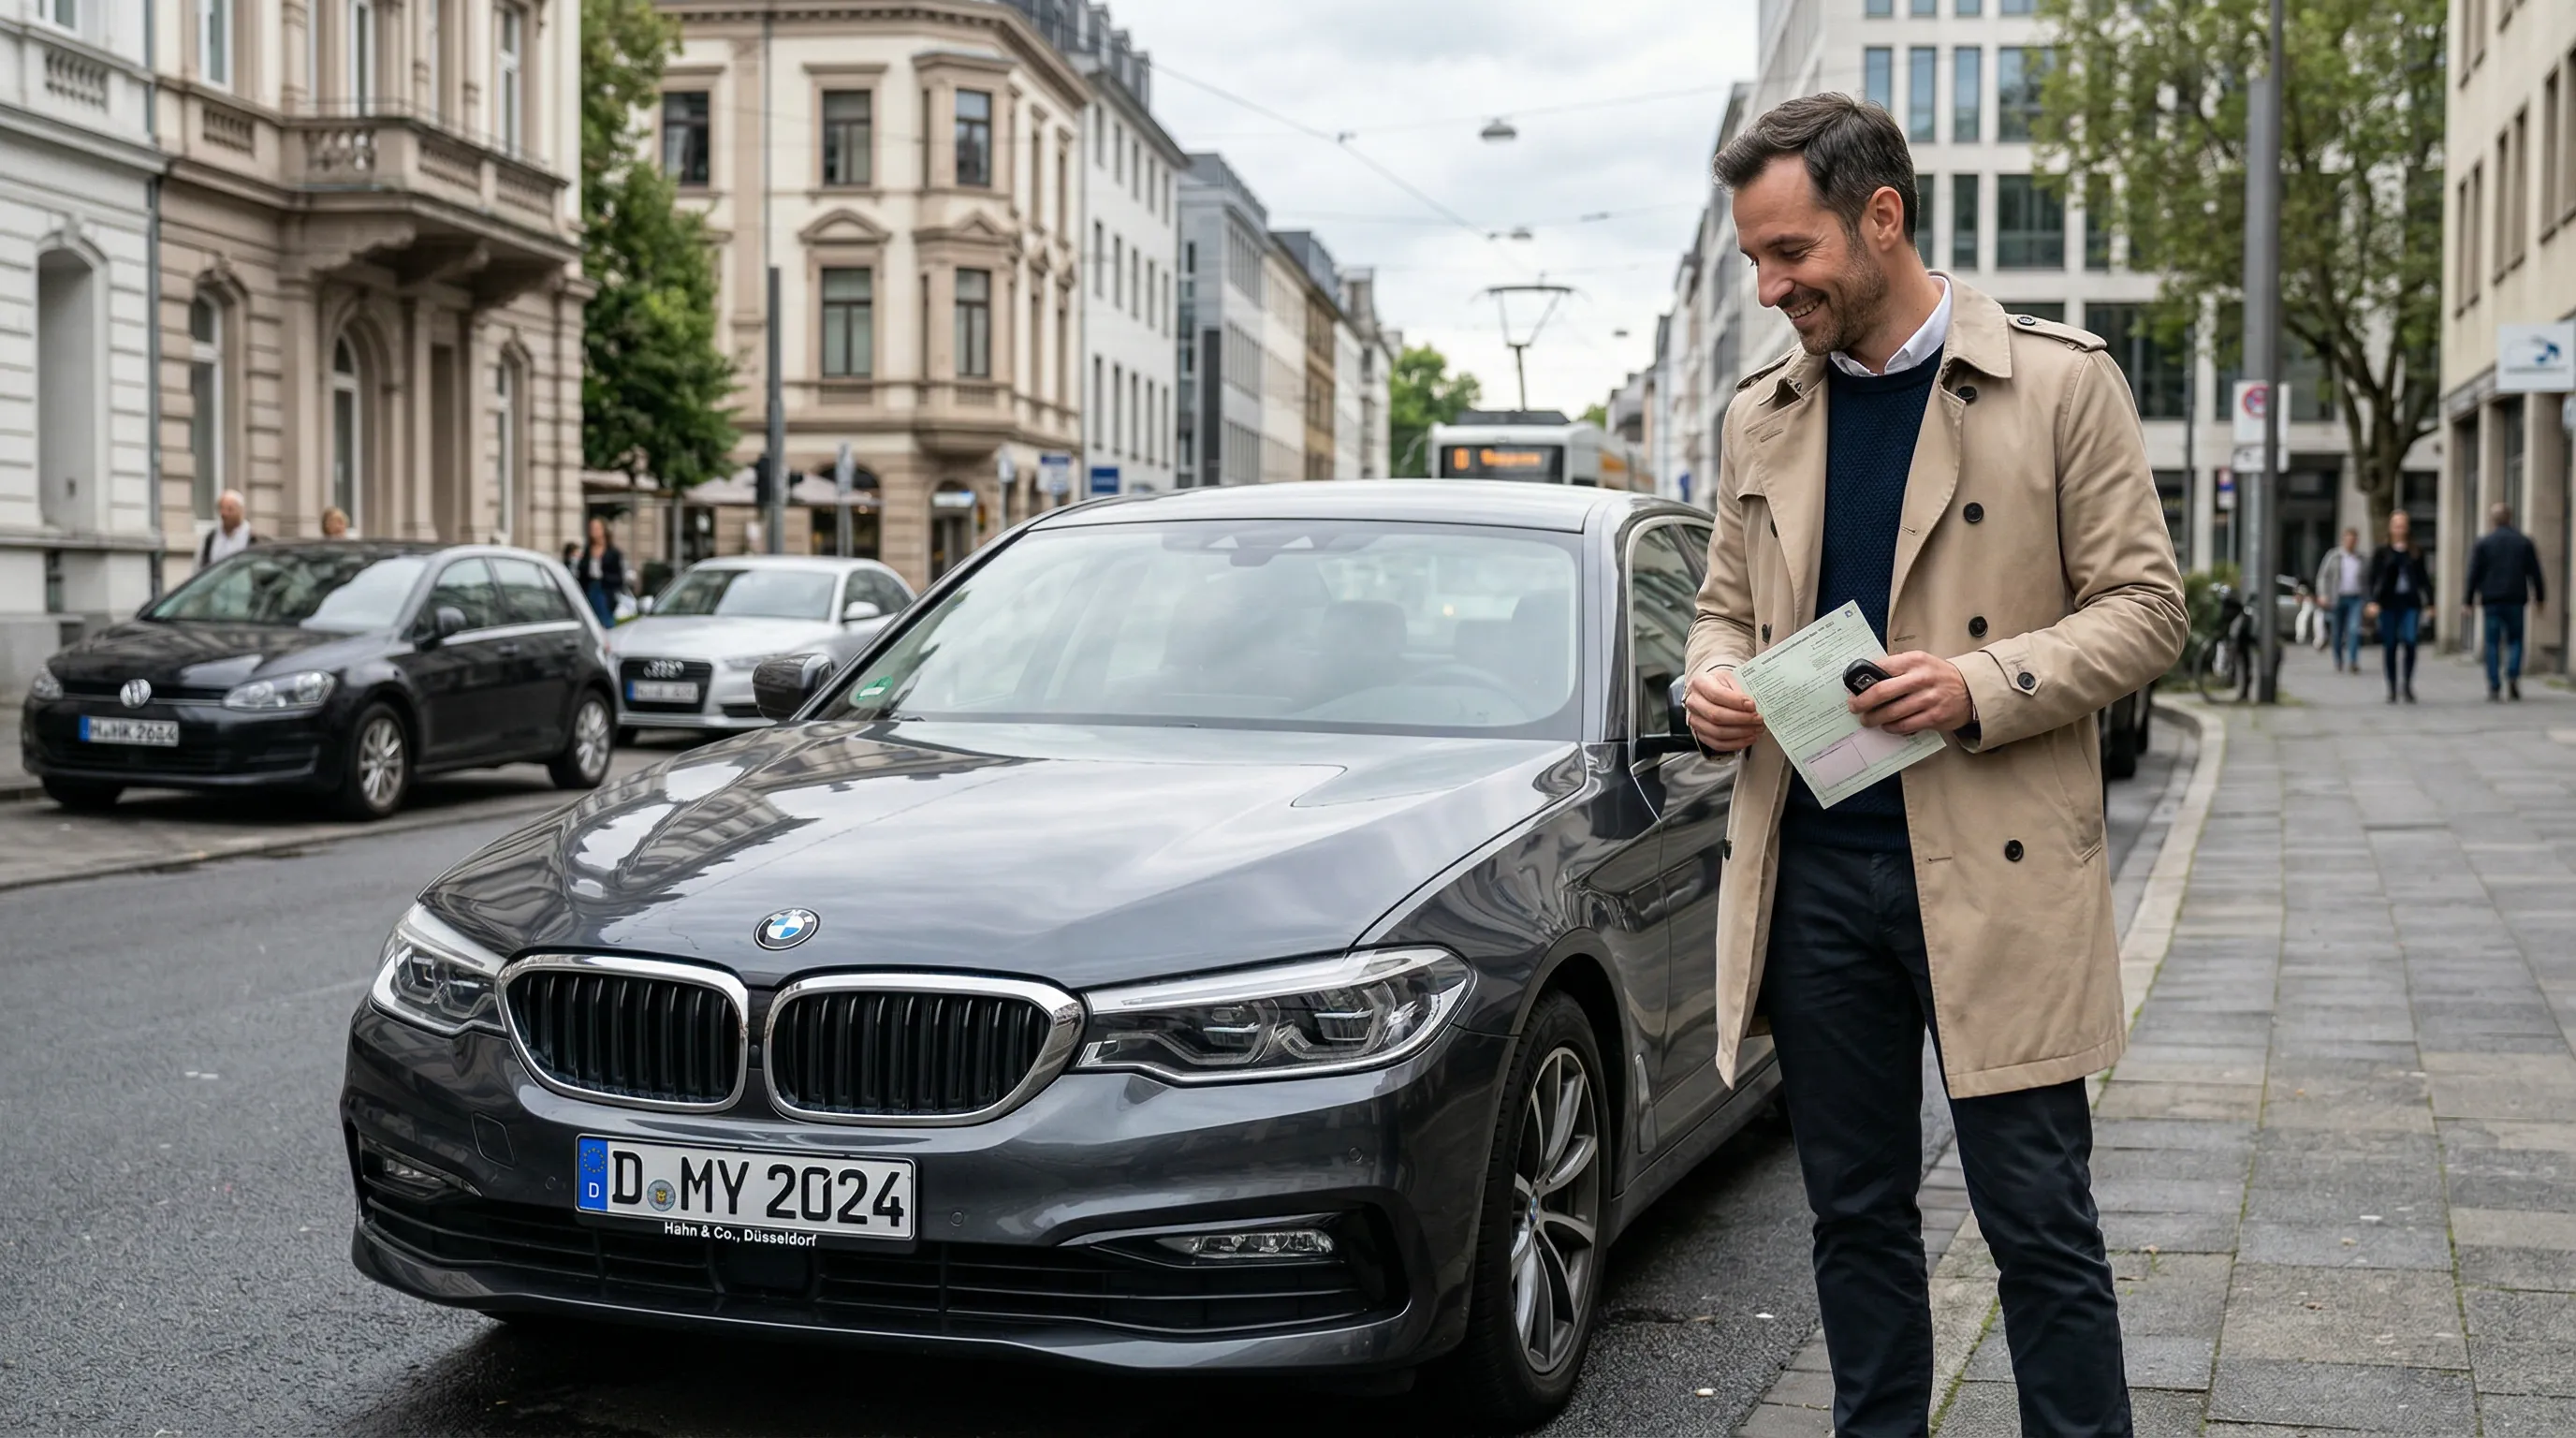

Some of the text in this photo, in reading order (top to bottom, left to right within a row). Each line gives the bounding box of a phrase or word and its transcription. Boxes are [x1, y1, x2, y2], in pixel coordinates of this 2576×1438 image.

[589, 1181, 600, 1198] D
[612, 1150, 904, 1227] D MY 2024
[664, 1221, 817, 1247] Hahn & Co., Düsseldorf
